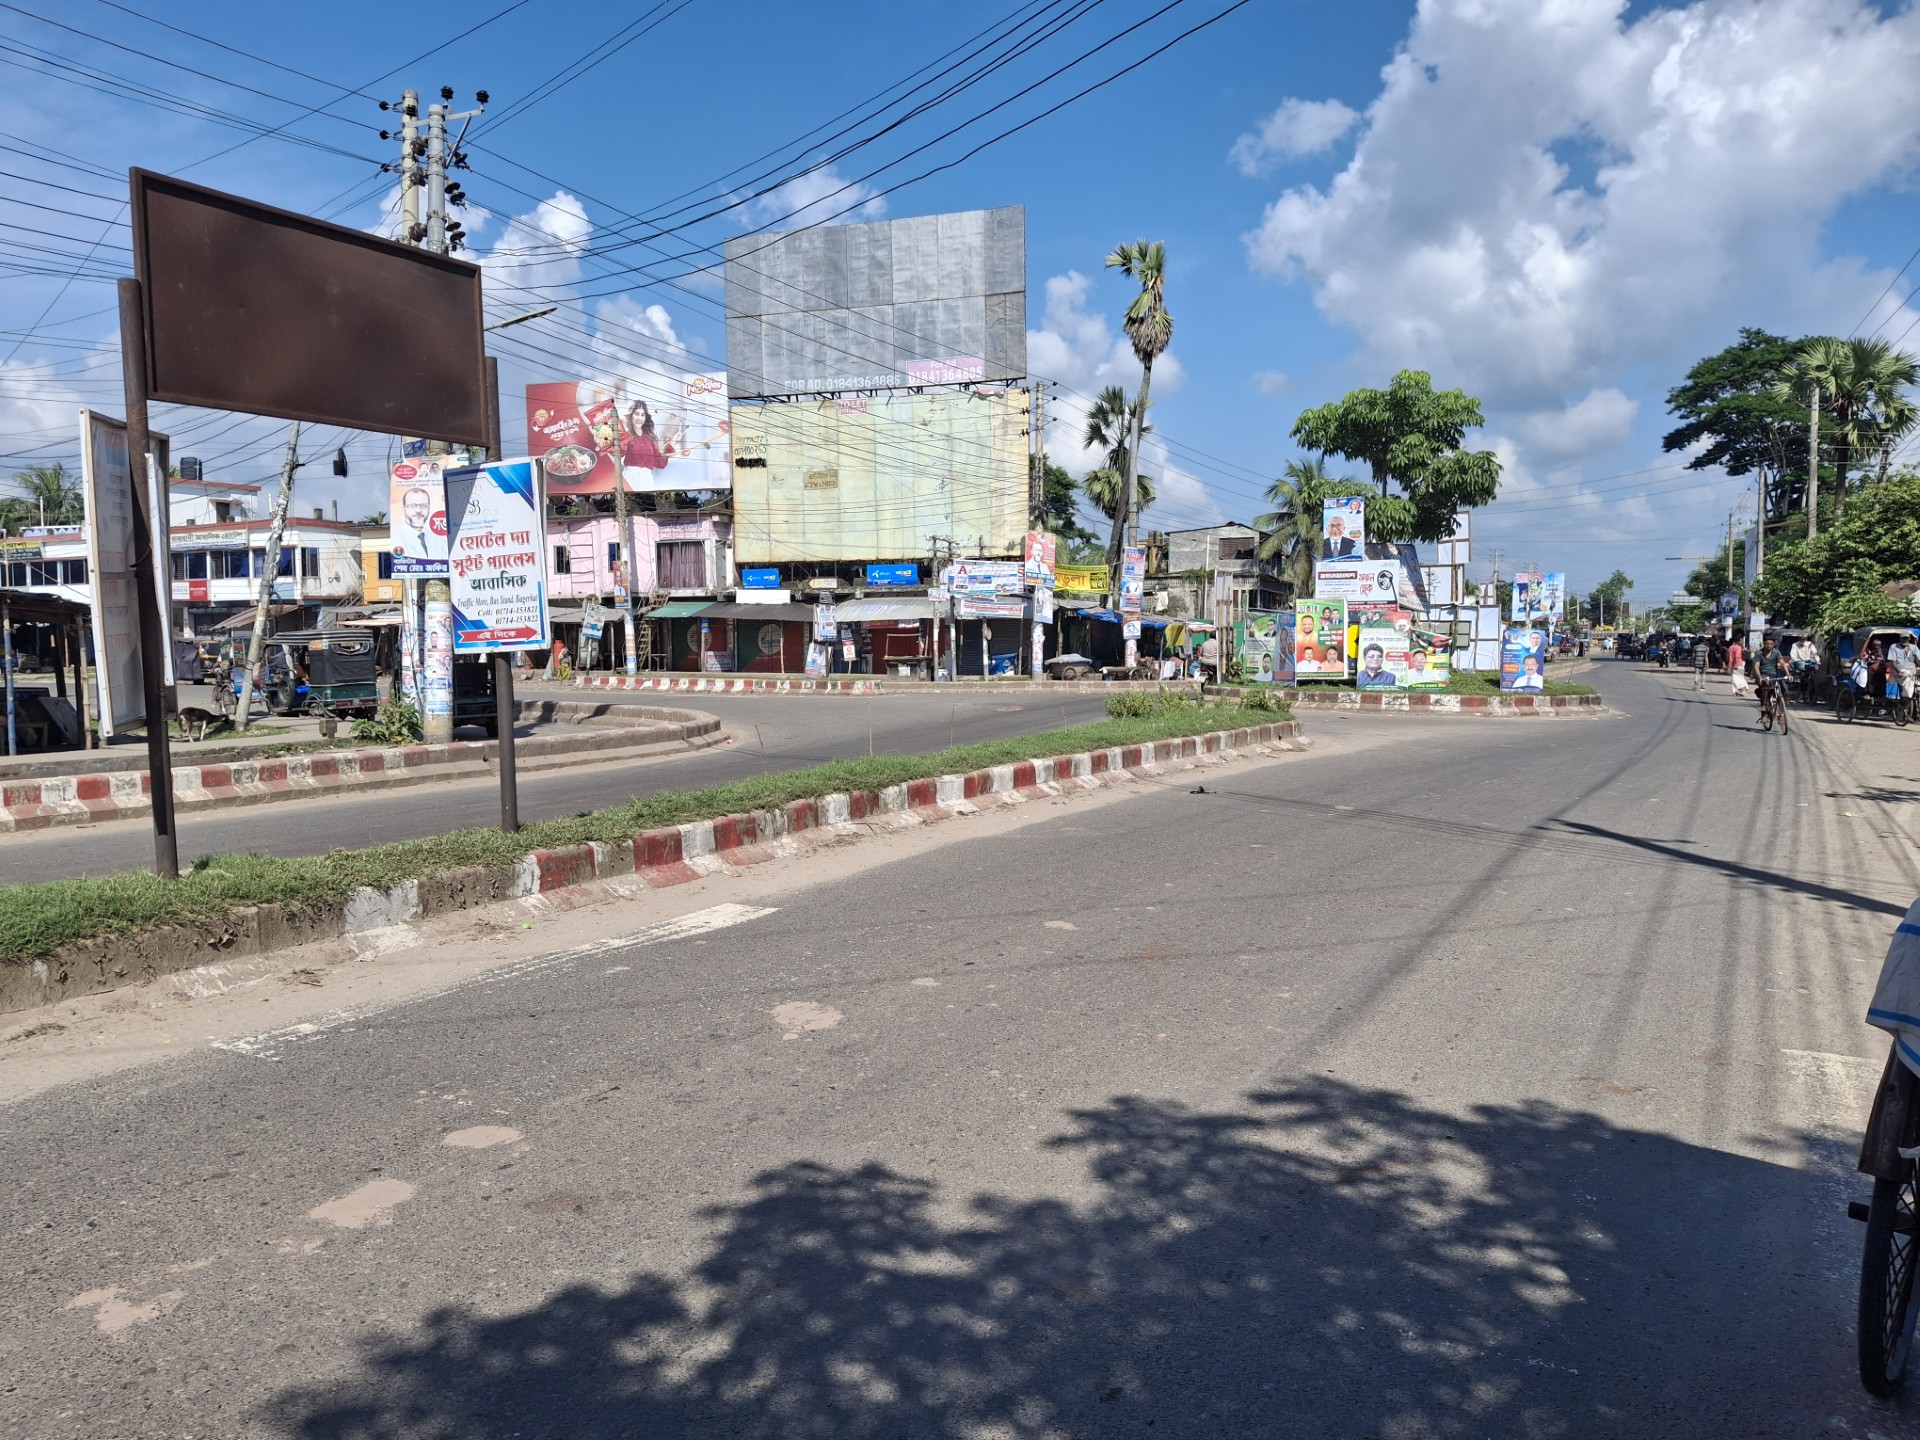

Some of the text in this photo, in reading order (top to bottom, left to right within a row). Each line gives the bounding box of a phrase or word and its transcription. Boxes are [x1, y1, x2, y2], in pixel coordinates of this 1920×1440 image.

[930, 359, 957, 369] For Ad
[826, 374, 901, 389] 01841364885
[908, 366, 983, 385] 01841364885
[687, 377, 722, 396] Noodles
[459, 531, 507, 551] হোটেল
[486, 551, 537, 570] প্যালেস
[469, 570, 528, 591] আবাসিক
[457, 598, 474, 609] Traffic
[489, 596, 500, 605] Bus
[515, 594, 538, 605] Bagerhat
[478, 606, 538, 617] Cell: 01714-153821
[495, 615, 539, 624] 01714-153822
[477, 630, 517, 640] এই দিকে
